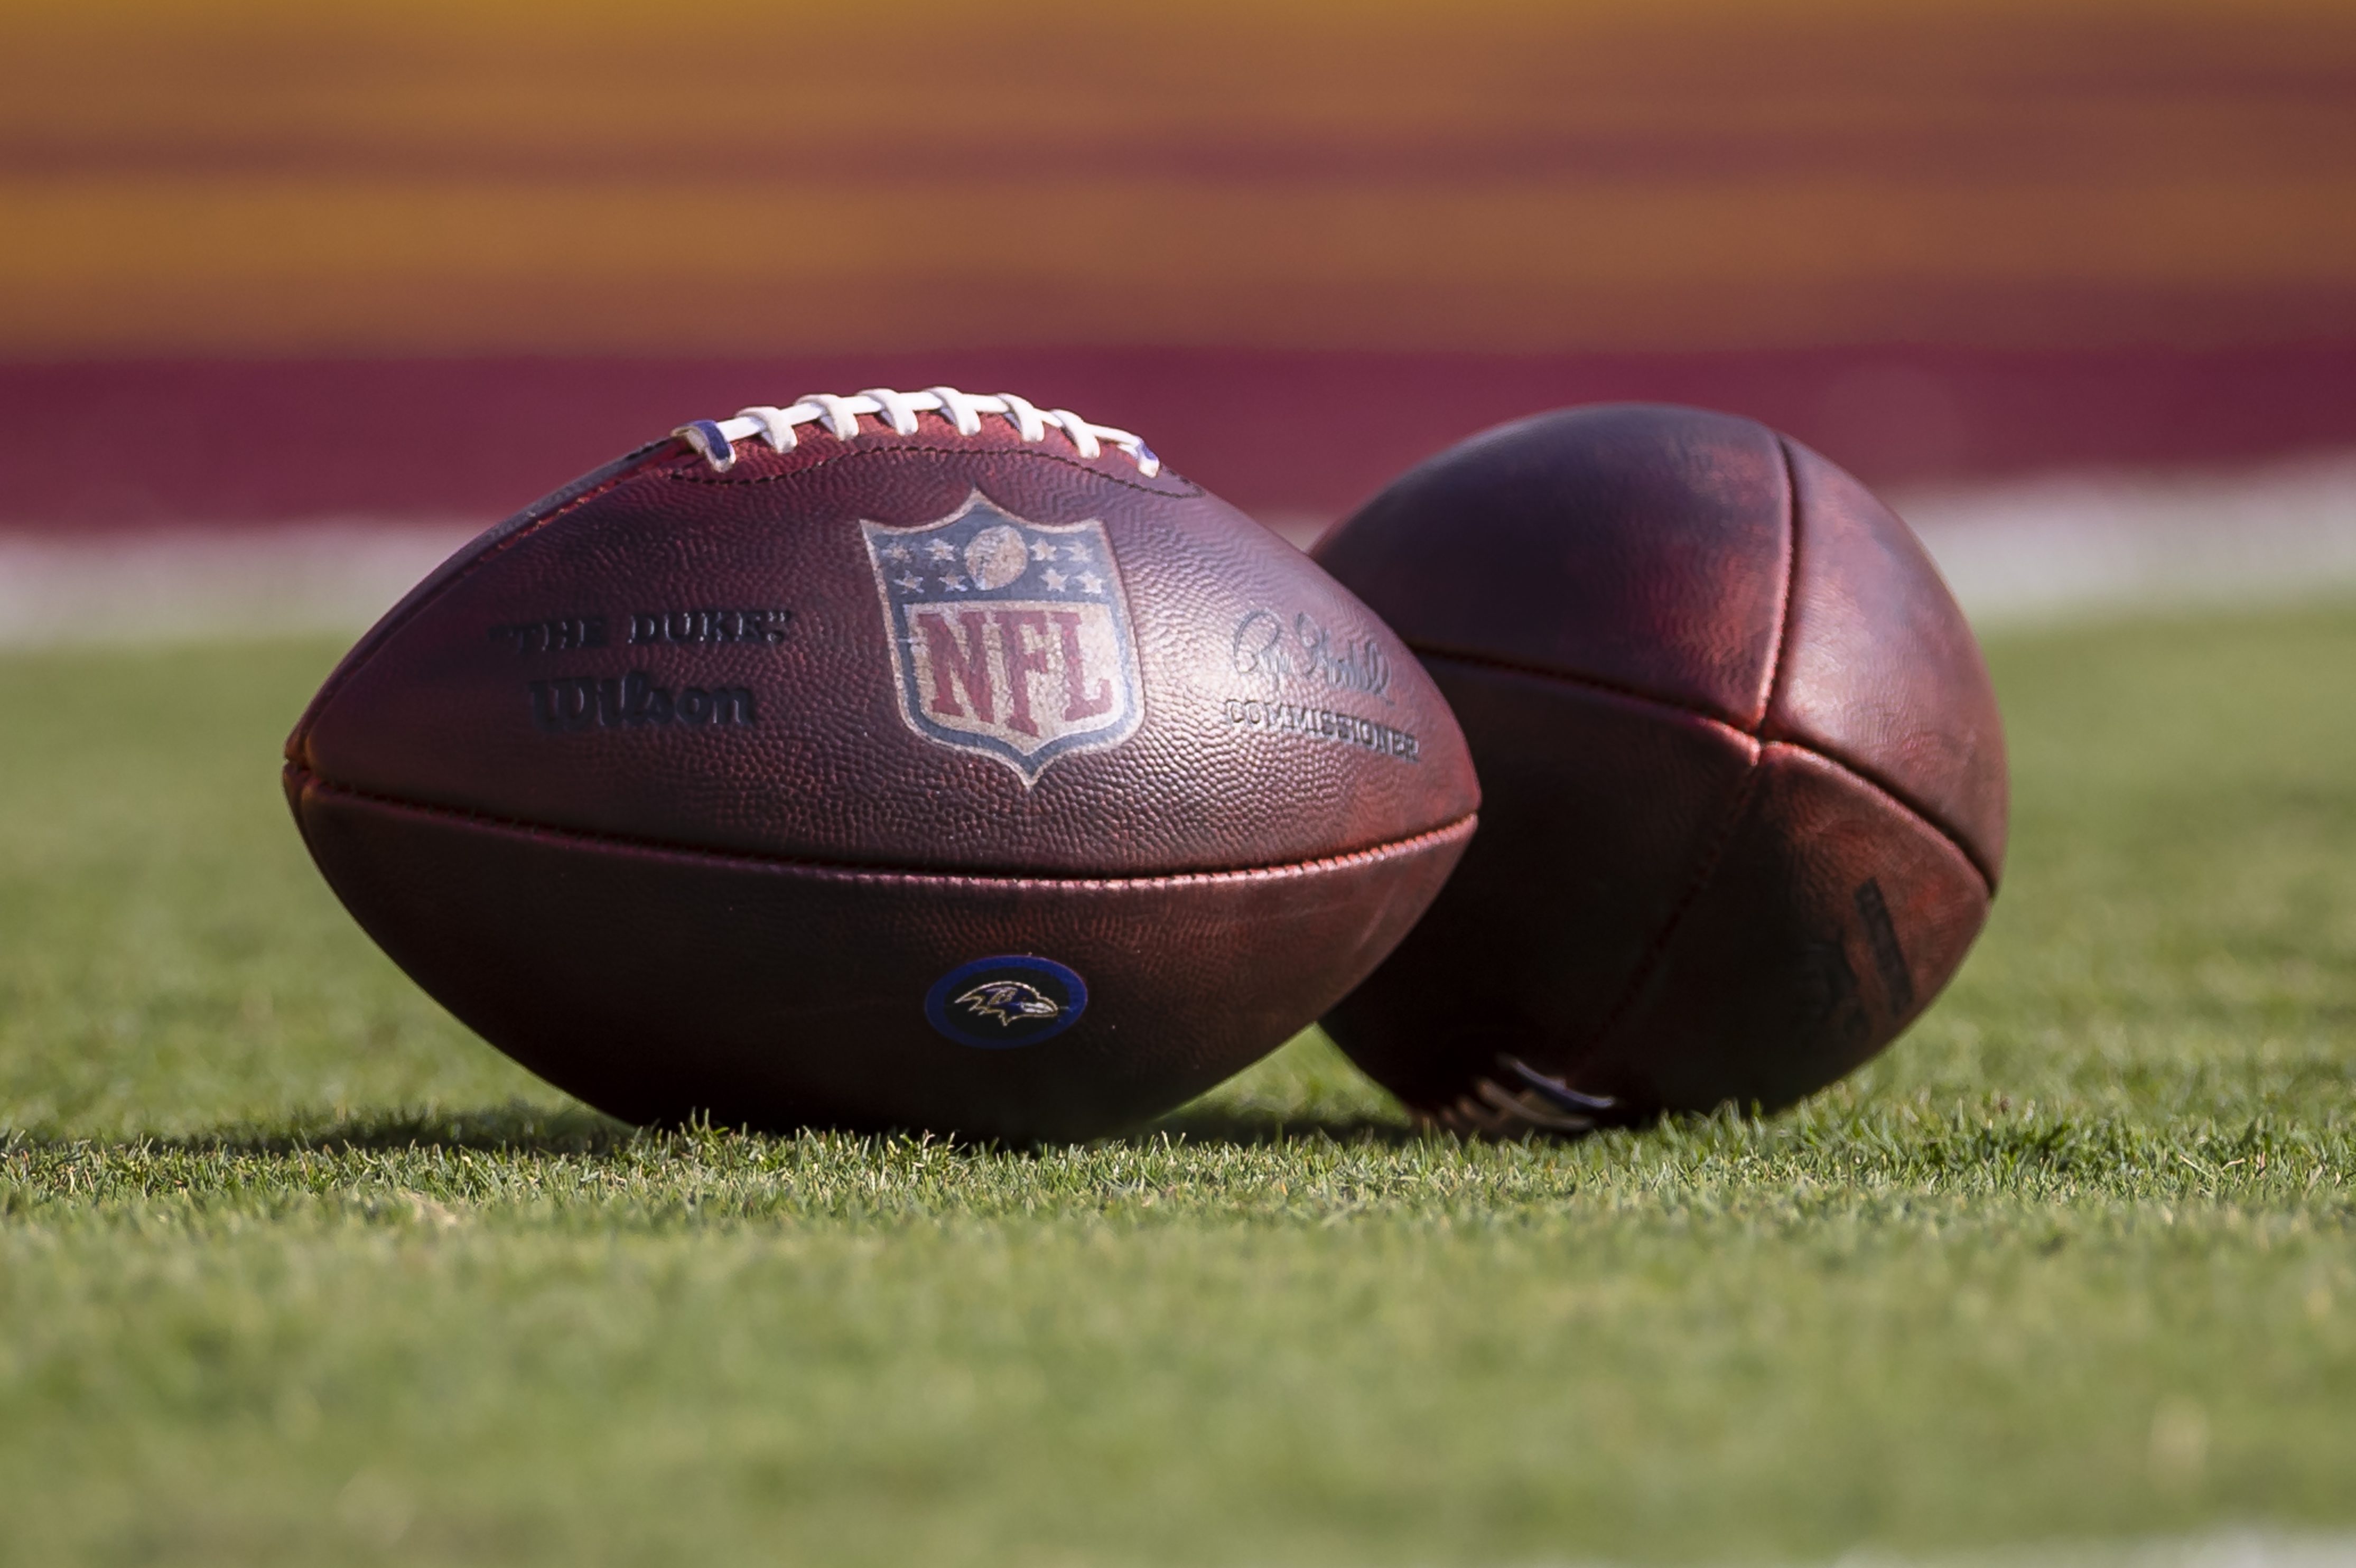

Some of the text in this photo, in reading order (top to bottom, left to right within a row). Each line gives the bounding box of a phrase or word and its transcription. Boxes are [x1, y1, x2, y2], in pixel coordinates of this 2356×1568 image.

[530, 671, 756, 732] Wilson
[917, 610, 1113, 738] NFL
[1225, 698, 1420, 763] COMMISSIONER
